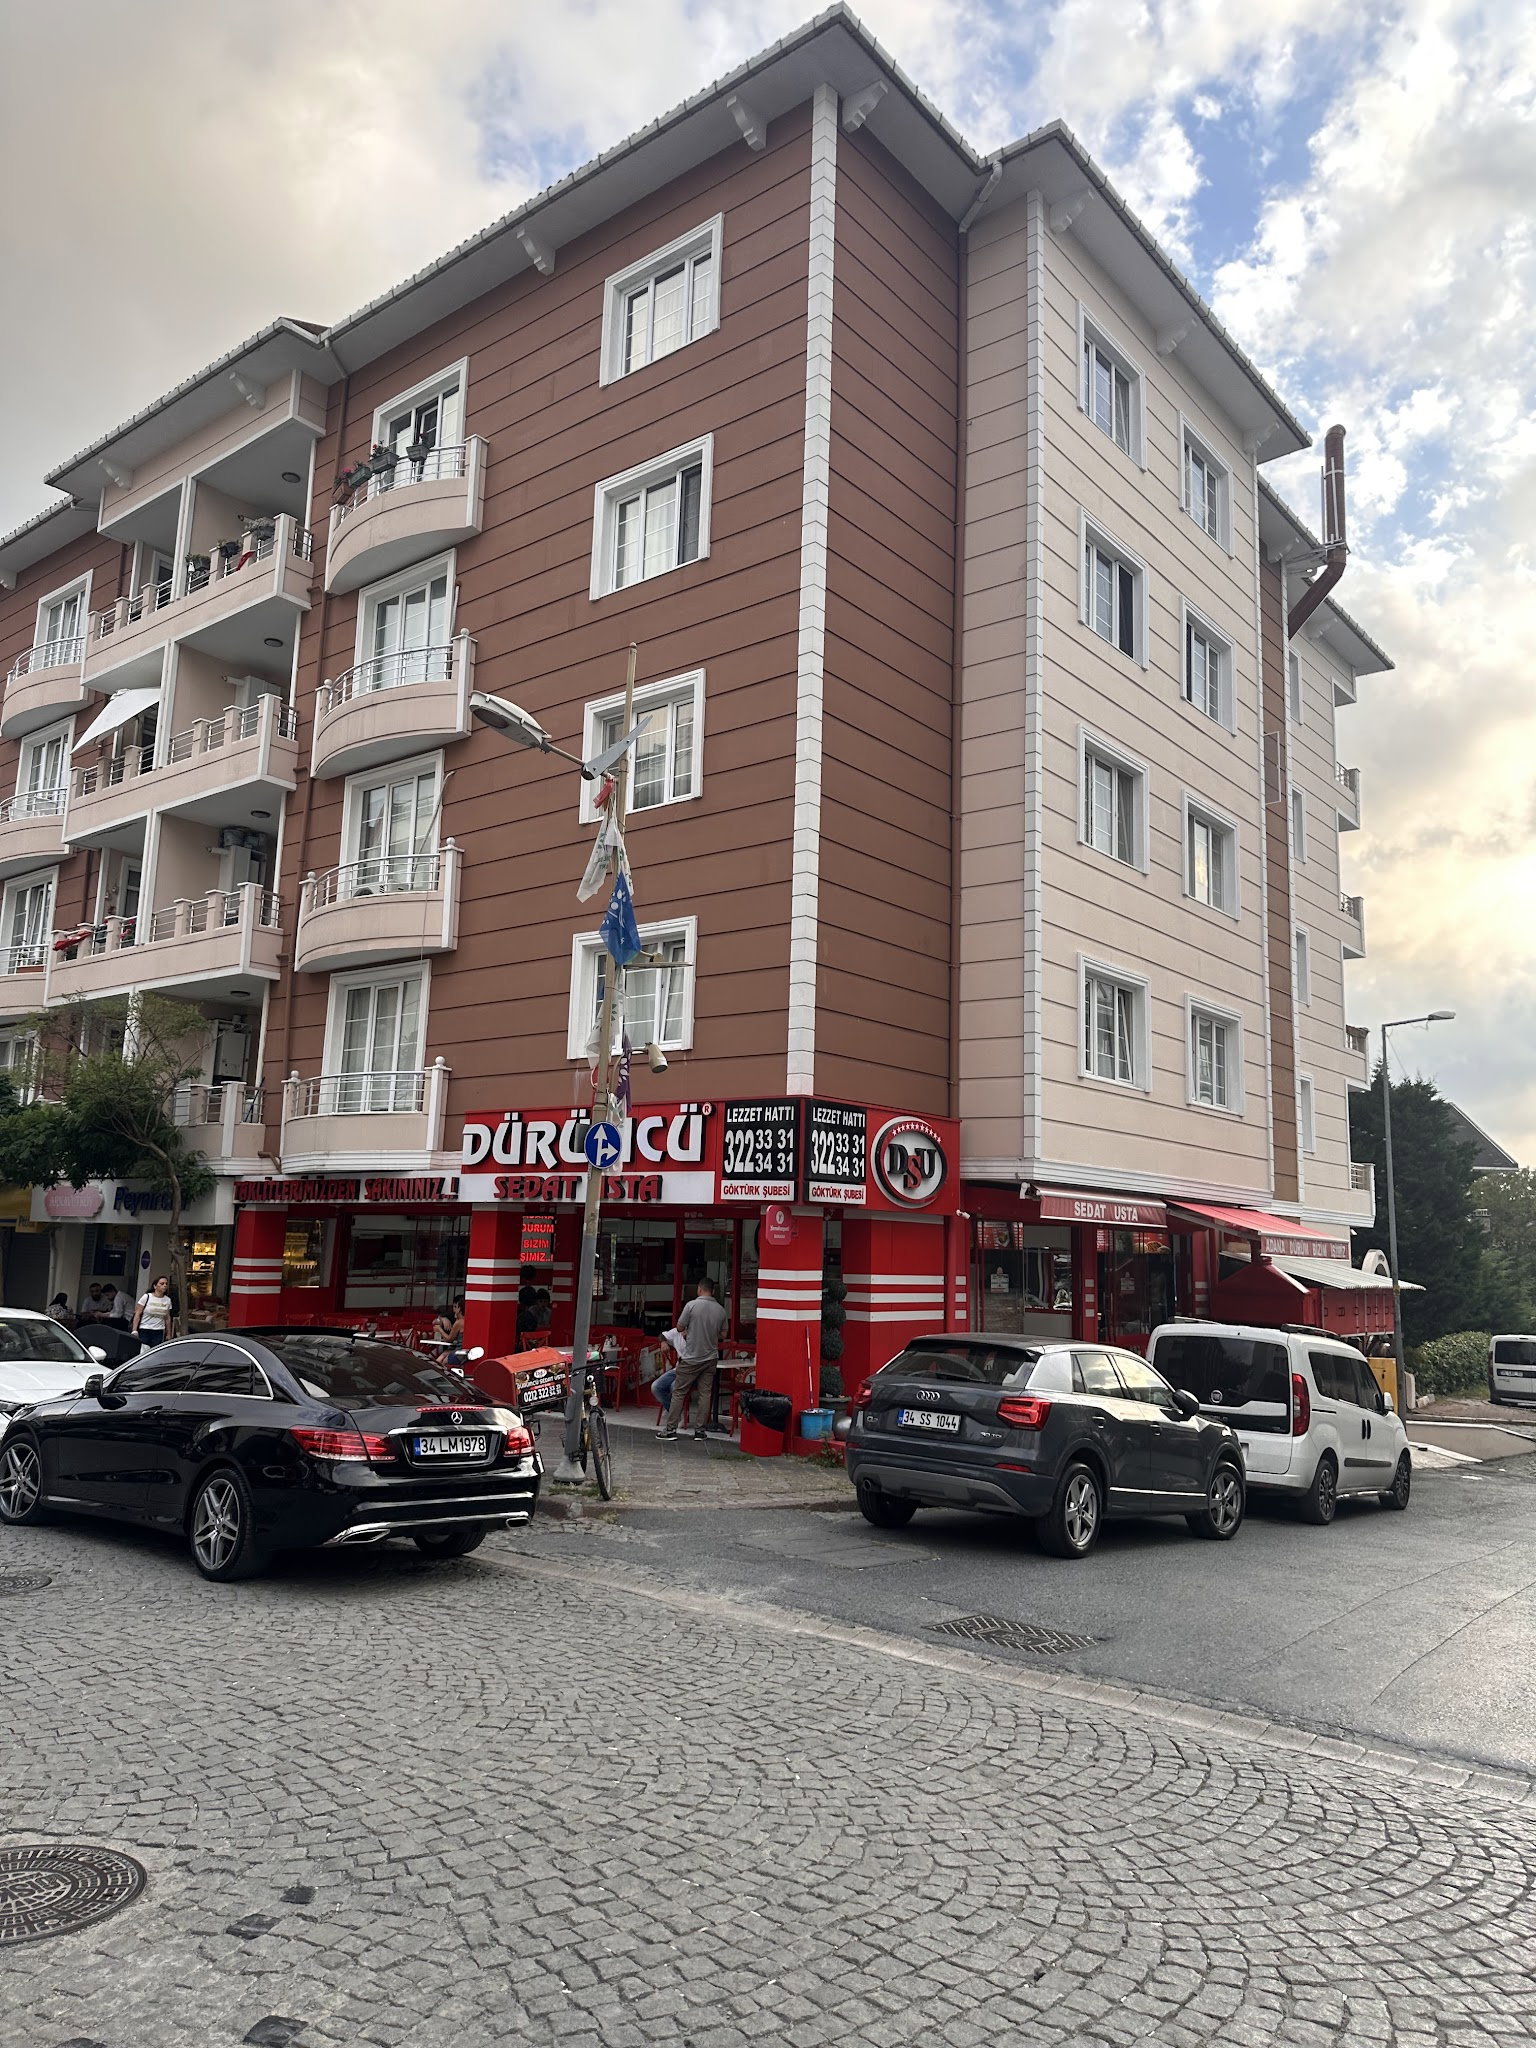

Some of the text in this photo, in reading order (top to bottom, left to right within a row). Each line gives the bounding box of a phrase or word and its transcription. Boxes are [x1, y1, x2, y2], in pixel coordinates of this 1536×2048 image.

[727, 1105, 794, 1123] LEZZET HATTI
[812, 1107, 866, 1128] LEZZET HATTI
[724, 1128, 794, 1174] 322 33 31
[811, 1129, 866, 1175] 322 33 31
[755, 1152, 794, 1173] 34 31
[836, 1156, 866, 1178] 34 31
[494, 1175, 663, 1200] SEDAT STA
[723, 1183, 791, 1198] GÖKTÜRK ŞUBESİ
[812, 1186, 864, 1202] GÖKTÜRK ŞUBESİ
[1074, 1201, 1138, 1221] SEDAT USTA
[523, 1389, 538, 1403] 0212
[538, 1387, 549, 1399] 322
[903, 1411, 915, 1424] 34
[920, 1413, 932, 1426] SS
[936, 1415, 957, 1429] 1044
[421, 1438, 436, 1453] 34
[440, 1437, 458, 1452] LM
[460, 1436, 486, 1451] 1978
